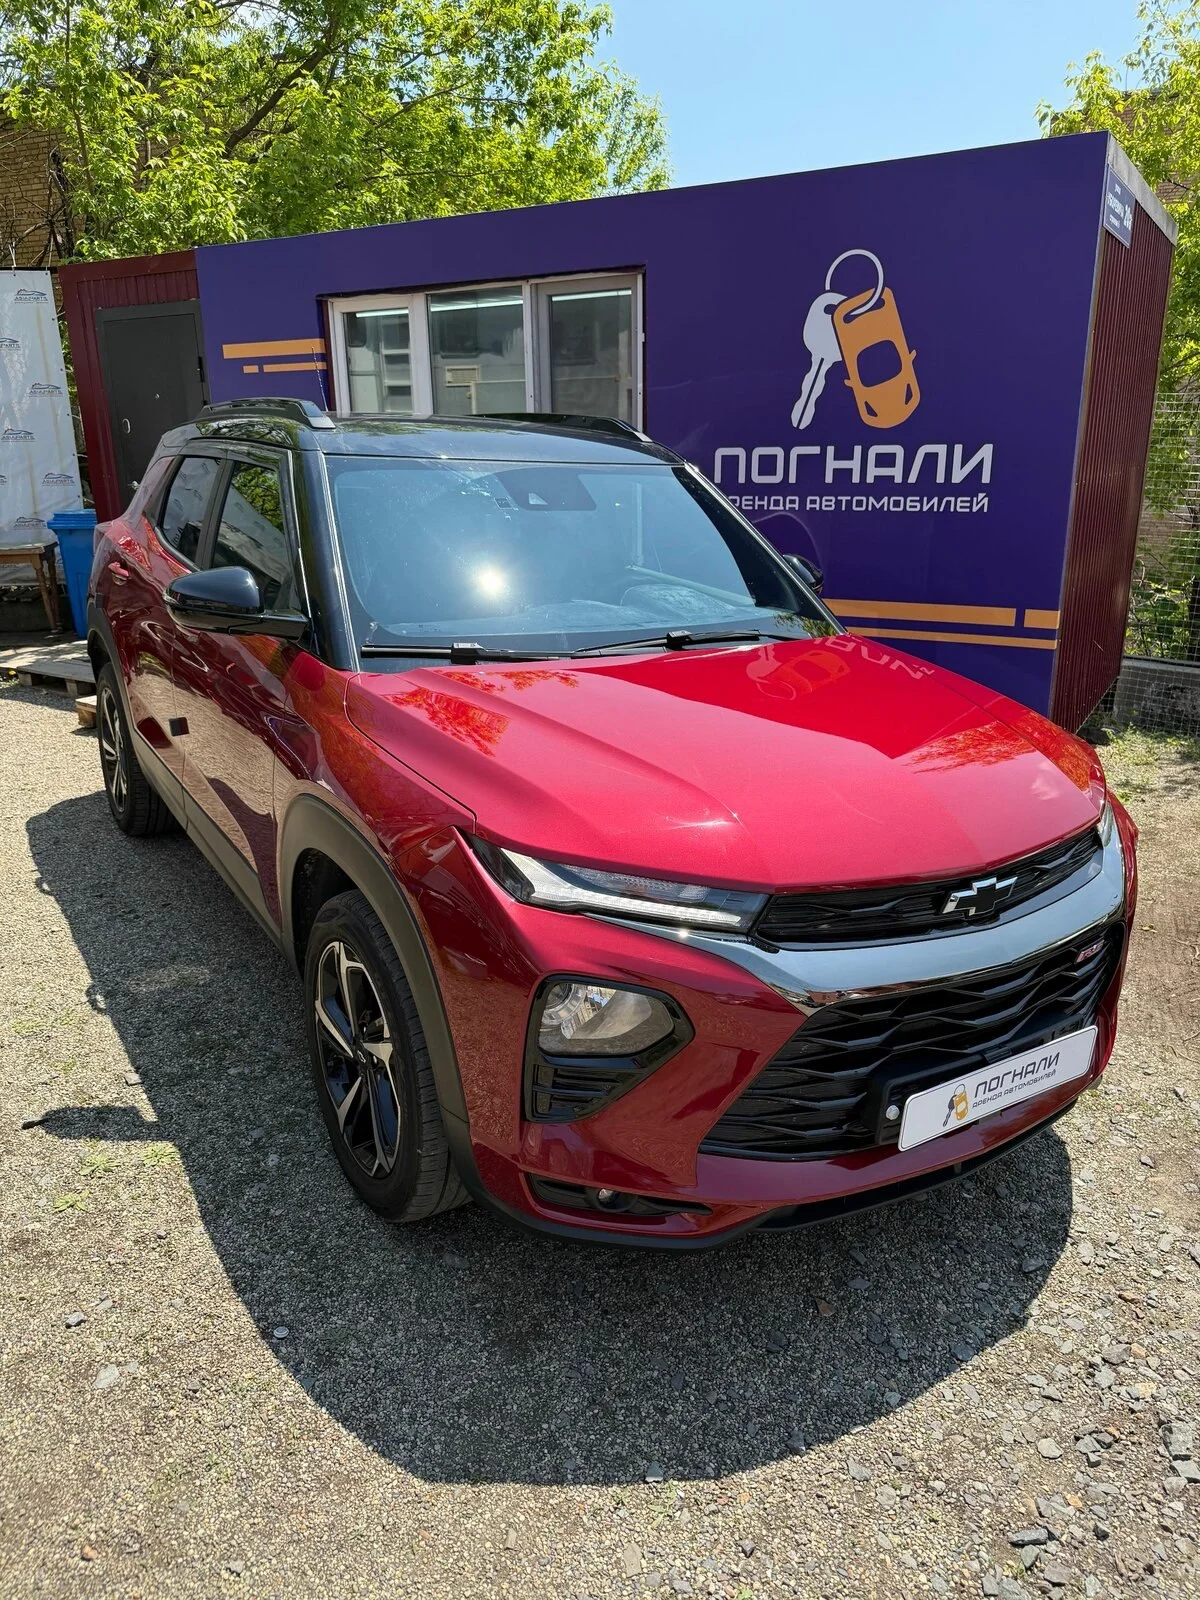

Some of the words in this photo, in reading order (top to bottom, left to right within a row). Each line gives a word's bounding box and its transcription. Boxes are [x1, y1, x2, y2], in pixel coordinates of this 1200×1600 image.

[714, 443, 994, 484] ПОГНАЛИ
[728, 495, 799, 511] РЕНДА
[806, 492, 989, 512] АВТОМОБИЛЕЙ
[972, 1091, 1003, 1109] АРЕНДА
[1003, 1068, 1057, 1096] АВТОМОБИЛЕЙ
[974, 1052, 1061, 1098] ПОГНАЛИ
